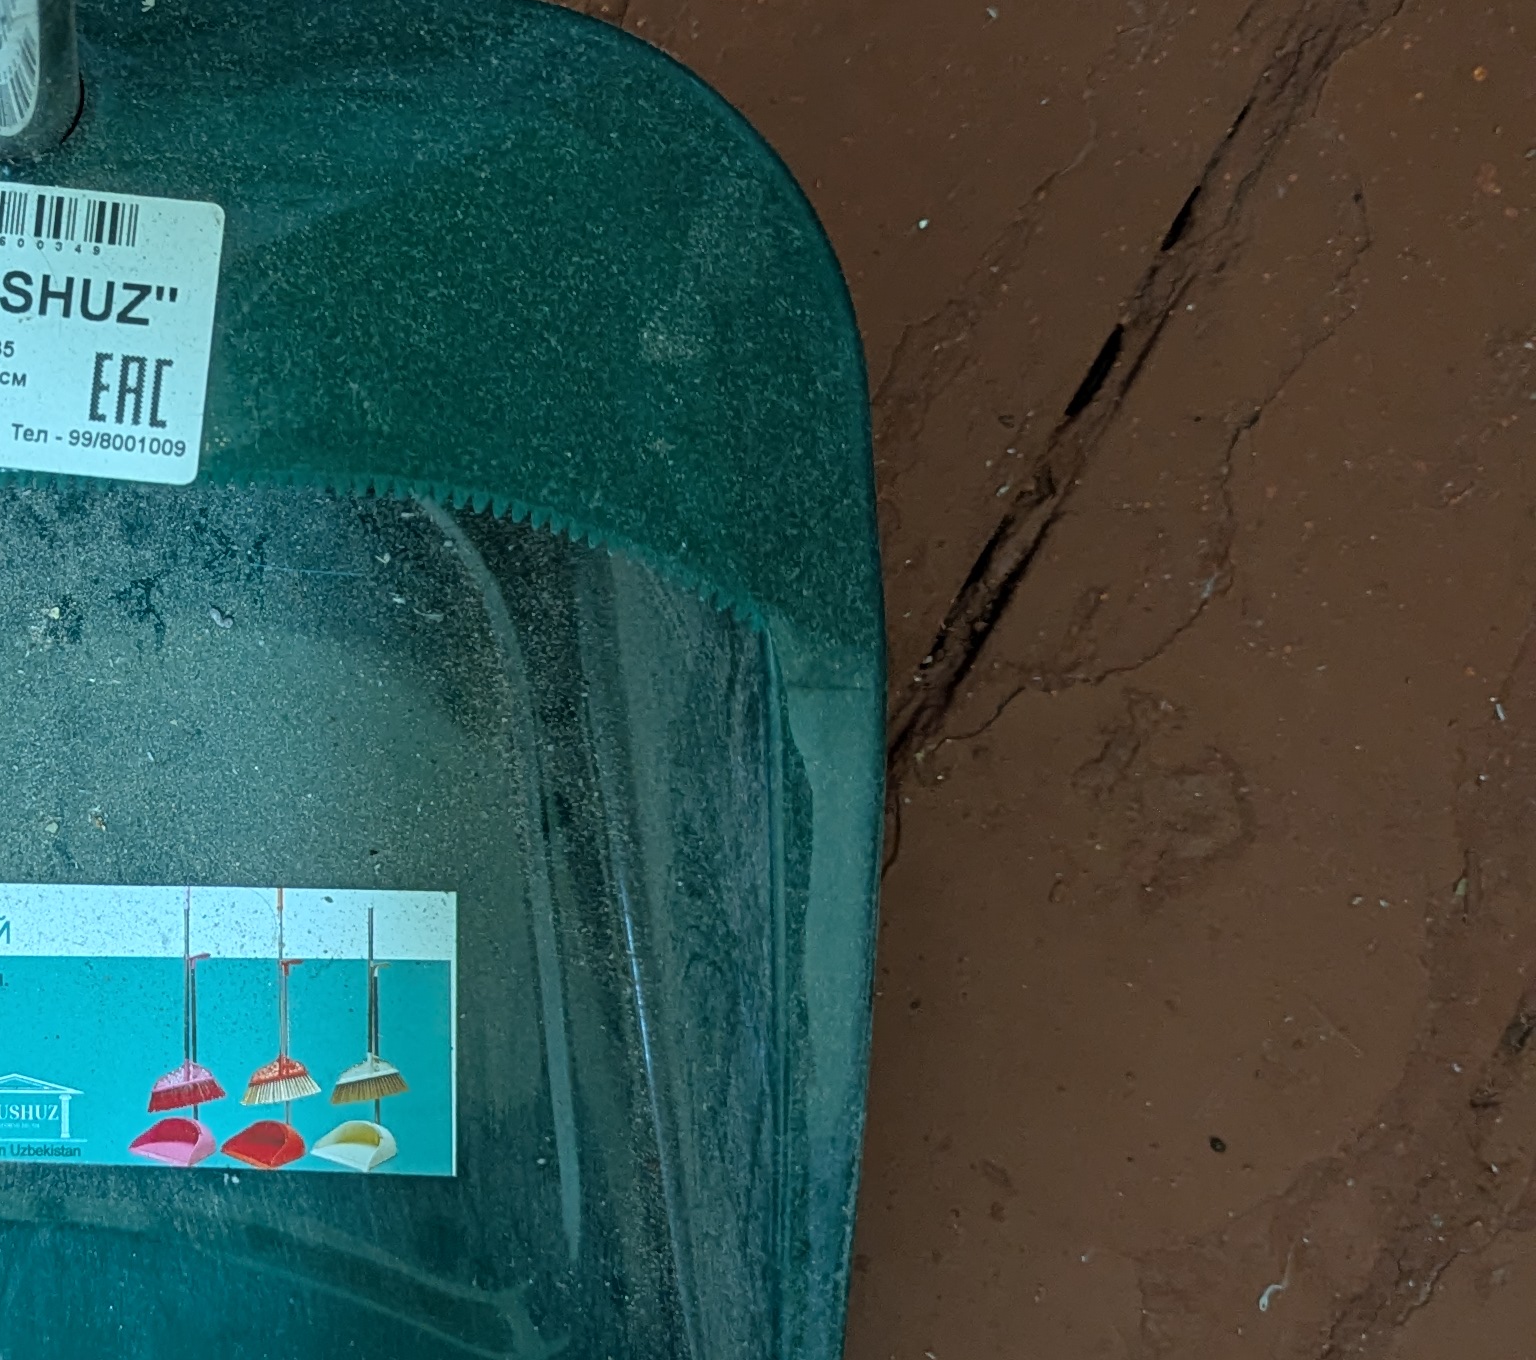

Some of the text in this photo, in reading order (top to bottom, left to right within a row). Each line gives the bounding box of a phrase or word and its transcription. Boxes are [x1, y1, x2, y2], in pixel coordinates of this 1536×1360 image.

[11, 423, 48, 444] Тел
[68, 429, 186, 457] 99/8001009
[10, 1144, 81, 1157] Uzbekistan
